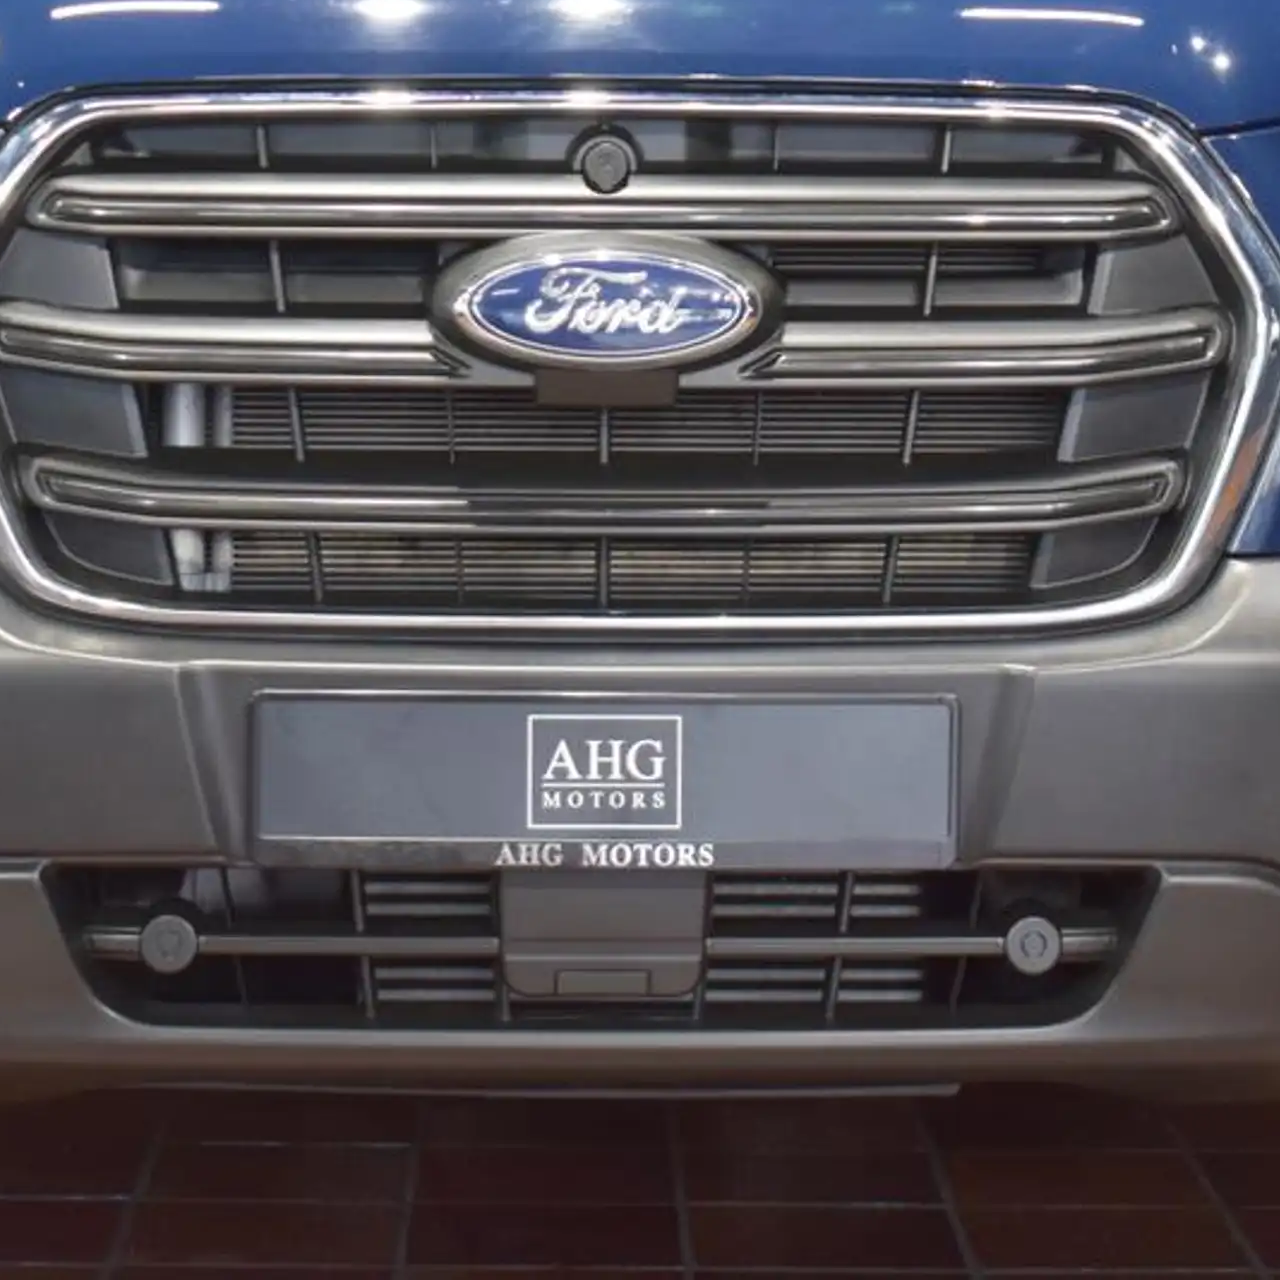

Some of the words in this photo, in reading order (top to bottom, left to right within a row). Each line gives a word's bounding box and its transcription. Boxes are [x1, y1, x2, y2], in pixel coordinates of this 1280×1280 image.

[524, 267, 688, 334] Ford
[541, 738, 667, 781] AHG
[542, 791, 666, 809] MOTORS
[494, 842, 564, 867] AHG
[581, 842, 716, 867] MOTORS
